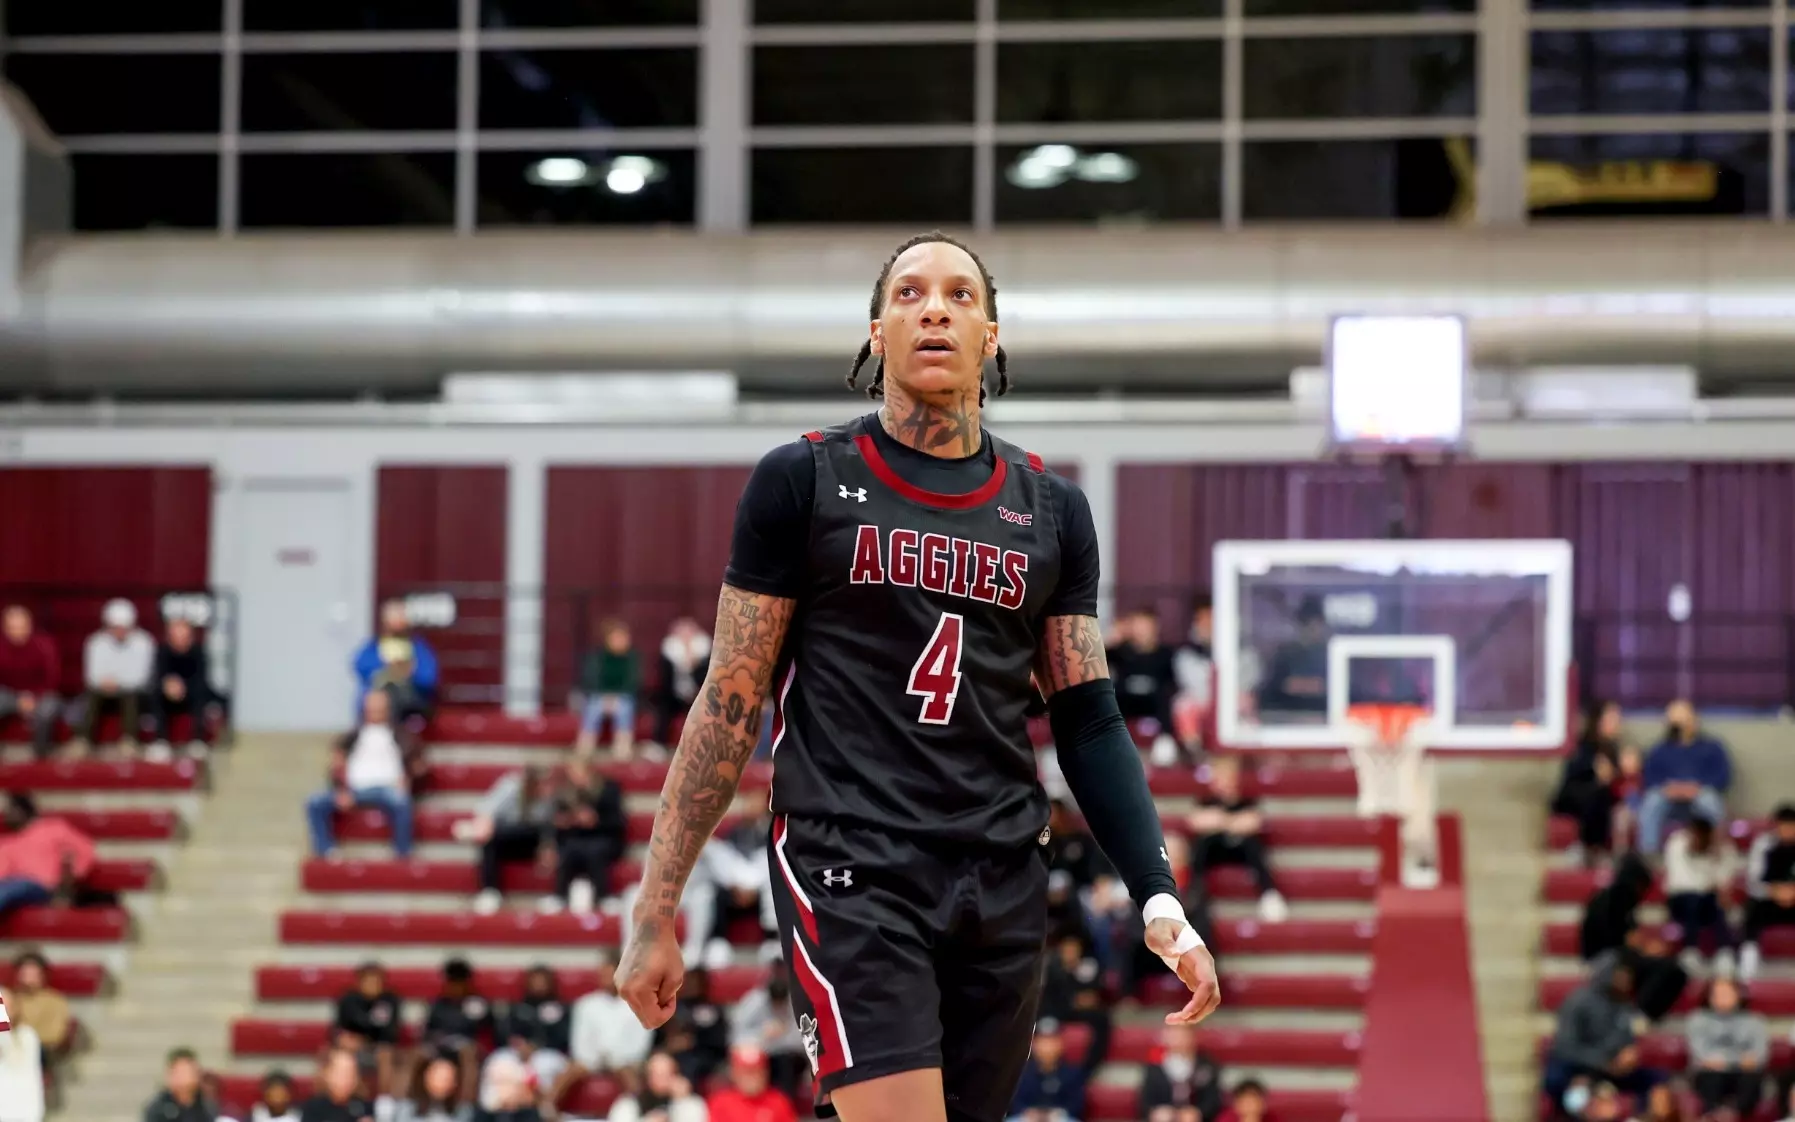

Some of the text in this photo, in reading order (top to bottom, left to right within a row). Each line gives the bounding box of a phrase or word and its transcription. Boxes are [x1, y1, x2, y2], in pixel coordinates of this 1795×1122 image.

[997, 506, 1032, 525] WAC
[850, 525, 1028, 610] AGGIES
[906, 612, 964, 725] 4
